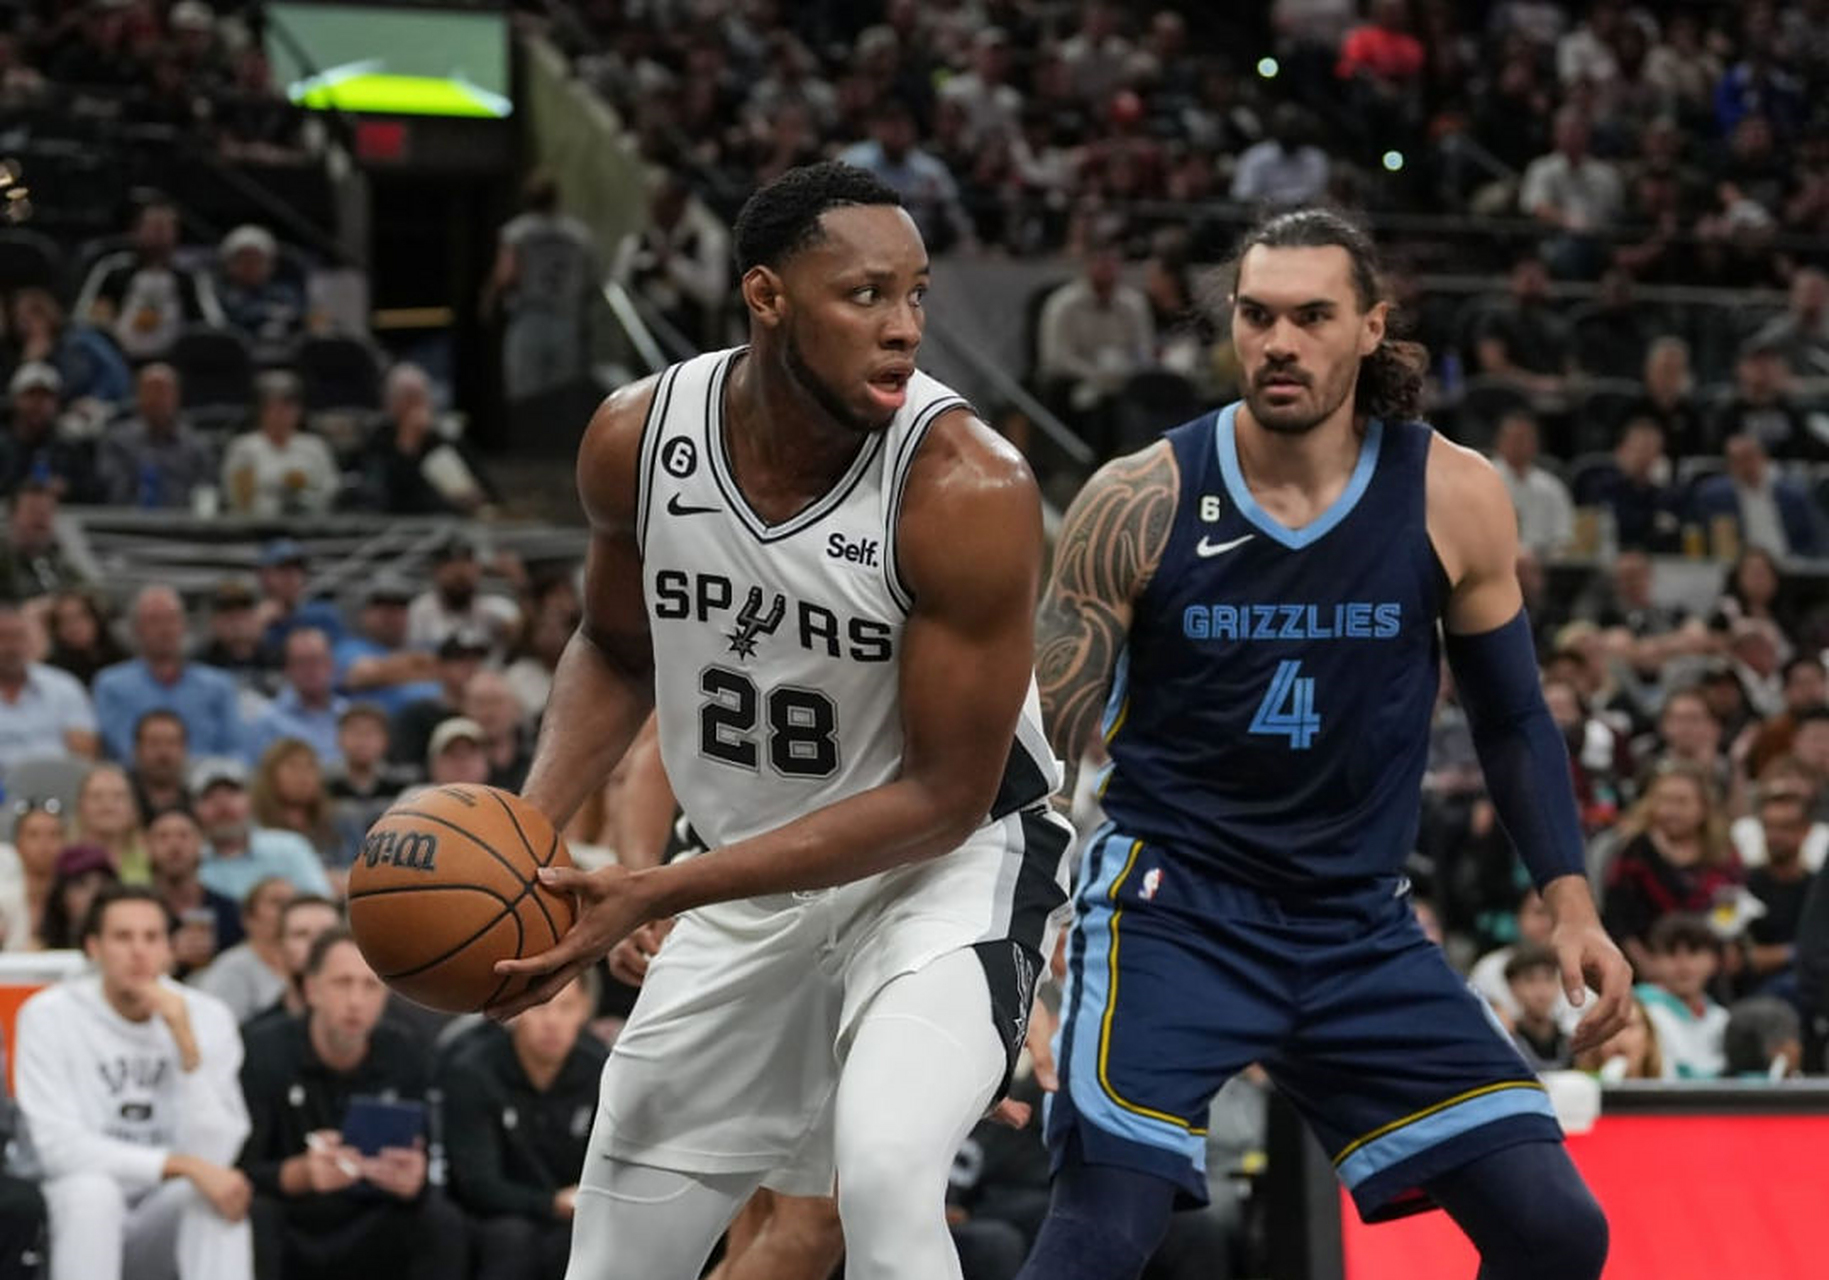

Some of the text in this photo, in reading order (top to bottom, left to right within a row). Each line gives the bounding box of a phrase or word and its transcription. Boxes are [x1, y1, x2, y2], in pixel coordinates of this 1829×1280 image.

[669, 441, 692, 474] 6
[1200, 495, 1220, 522] 6
[826, 532, 879, 568] Self.
[655, 569, 893, 662] SPURS
[1183, 602, 1402, 640] GRIZZLIES
[698, 662, 841, 781] 28
[1248, 659, 1321, 749] 4
